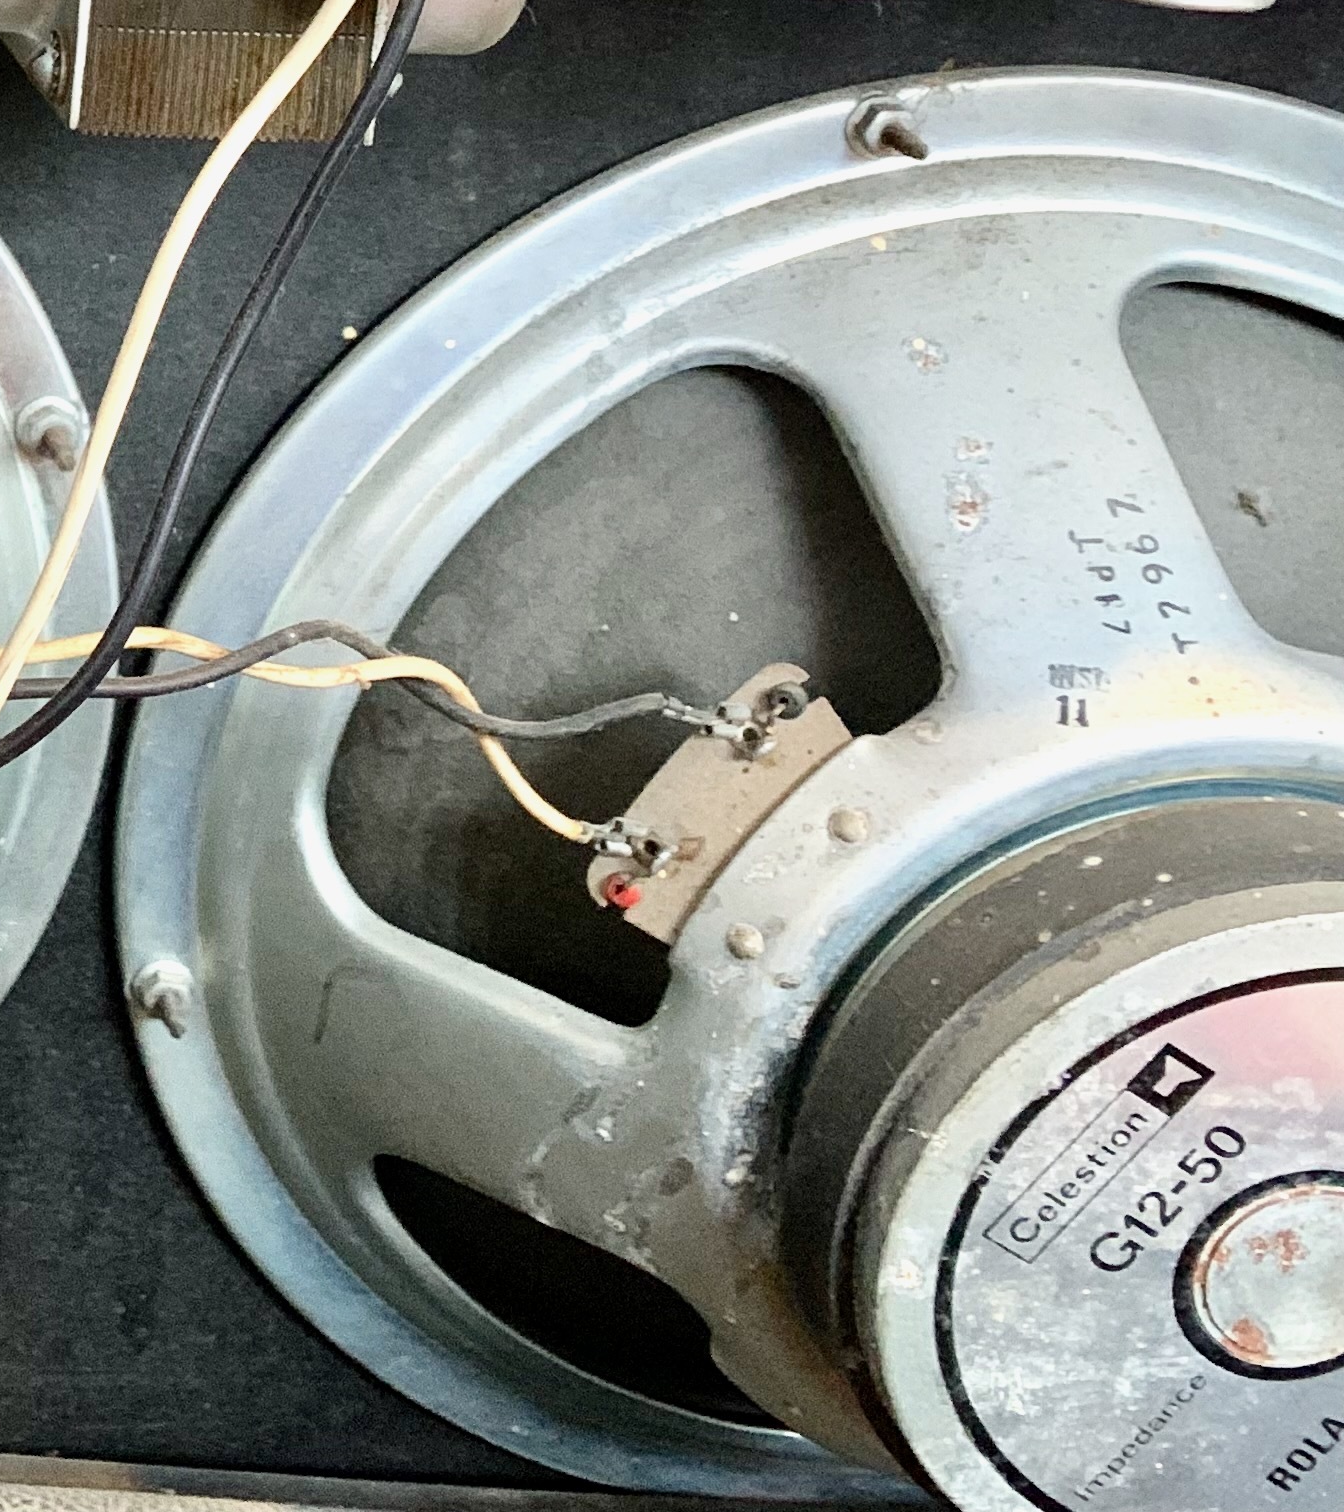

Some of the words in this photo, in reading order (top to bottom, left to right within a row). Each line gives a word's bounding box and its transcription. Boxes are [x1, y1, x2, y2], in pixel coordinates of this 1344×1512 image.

[1010, 1113, 1147, 1242] Celestion
[1090, 1126, 1246, 1272] G12-50
[1076, 1374, 1206, 1502] Impedance
[1266, 1418, 1344, 1491] ROLA
